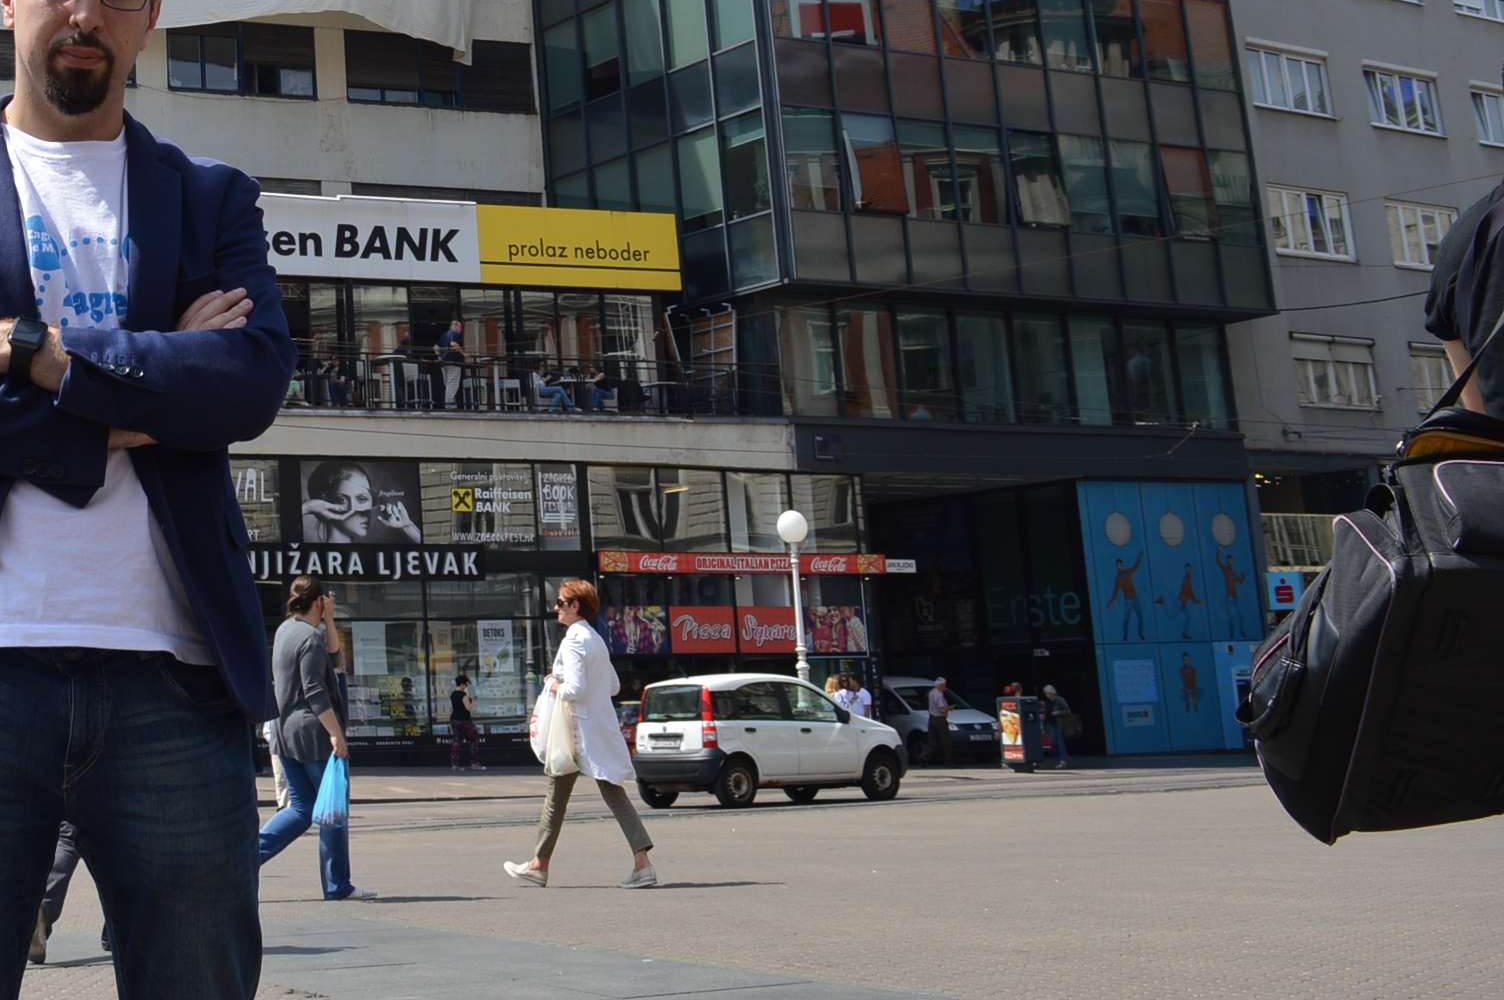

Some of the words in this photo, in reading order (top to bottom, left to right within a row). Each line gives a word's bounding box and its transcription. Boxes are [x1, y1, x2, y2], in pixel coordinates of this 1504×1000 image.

[335, 224, 460, 263] BANK
[508, 238, 568, 262] prolaz
[574, 240, 650, 263] neboder
[450, 471, 488, 481] Generalni
[474, 487, 532, 500] Raiffeisen
[543, 484, 575, 500] BOOK
[476, 501, 510, 513] BANK
[377, 551, 479, 580] LJEVAK
[696, 556, 736, 571] ORIGINAL
[737, 556, 769, 571] ITALIAN
[987, 586, 1083, 628] Erste
[673, 614, 732, 641] Pizza
[742, 613, 796, 647] Square
